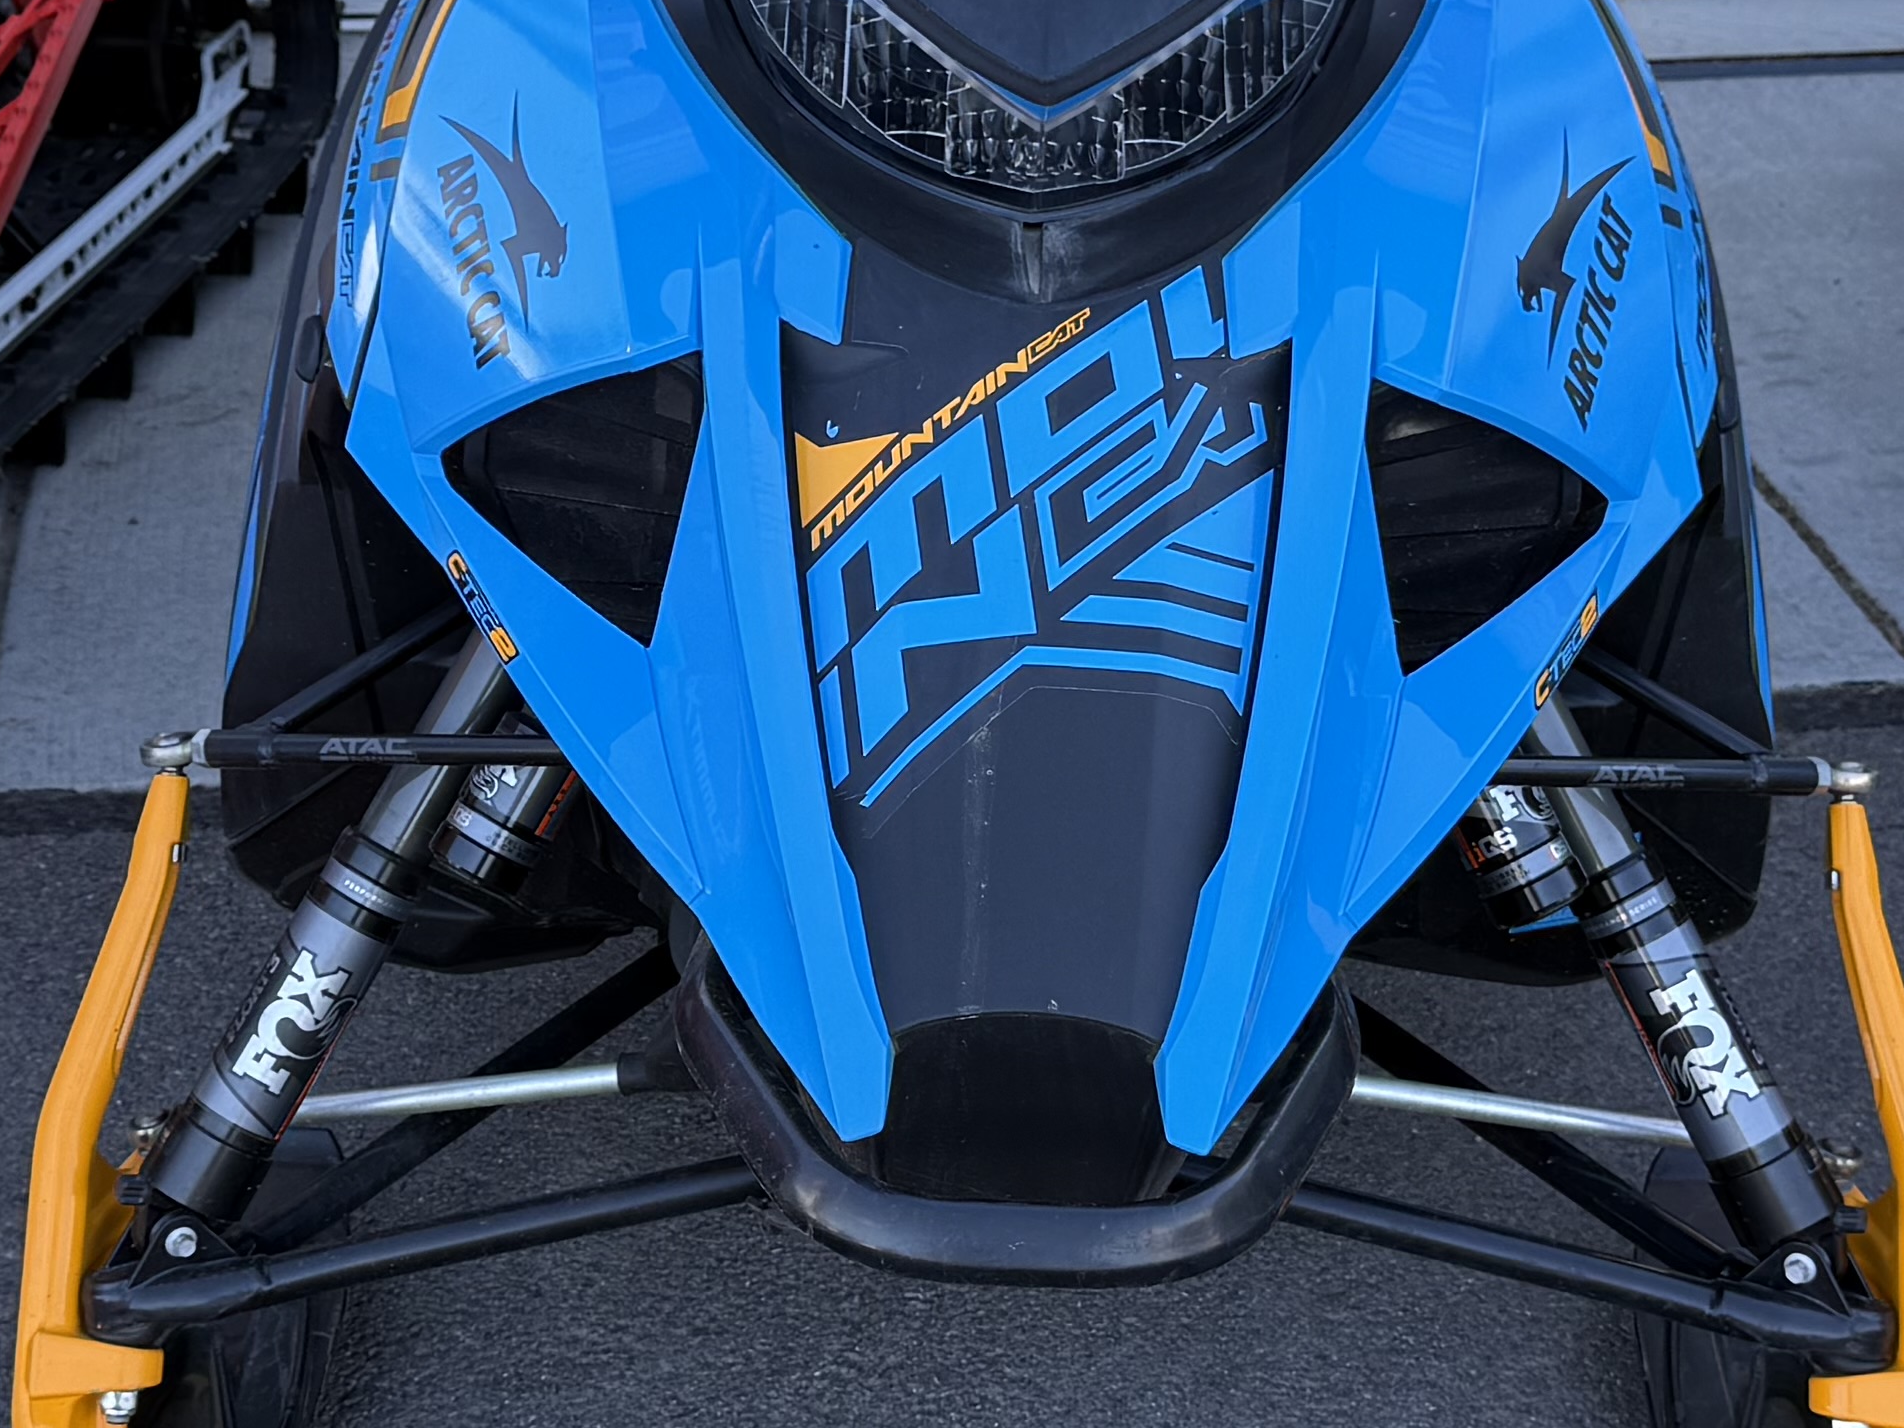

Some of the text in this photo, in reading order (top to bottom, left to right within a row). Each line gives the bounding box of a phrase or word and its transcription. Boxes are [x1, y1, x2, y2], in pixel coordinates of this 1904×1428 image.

[437, 154, 512, 370] ARCTIC CAT
[1562, 193, 1637, 433] ARCTIC CAT
[811, 308, 1091, 551] MOUNTAINCAT
[232, 949, 352, 1097] FOX
[1650, 968, 1759, 1119] FOX
